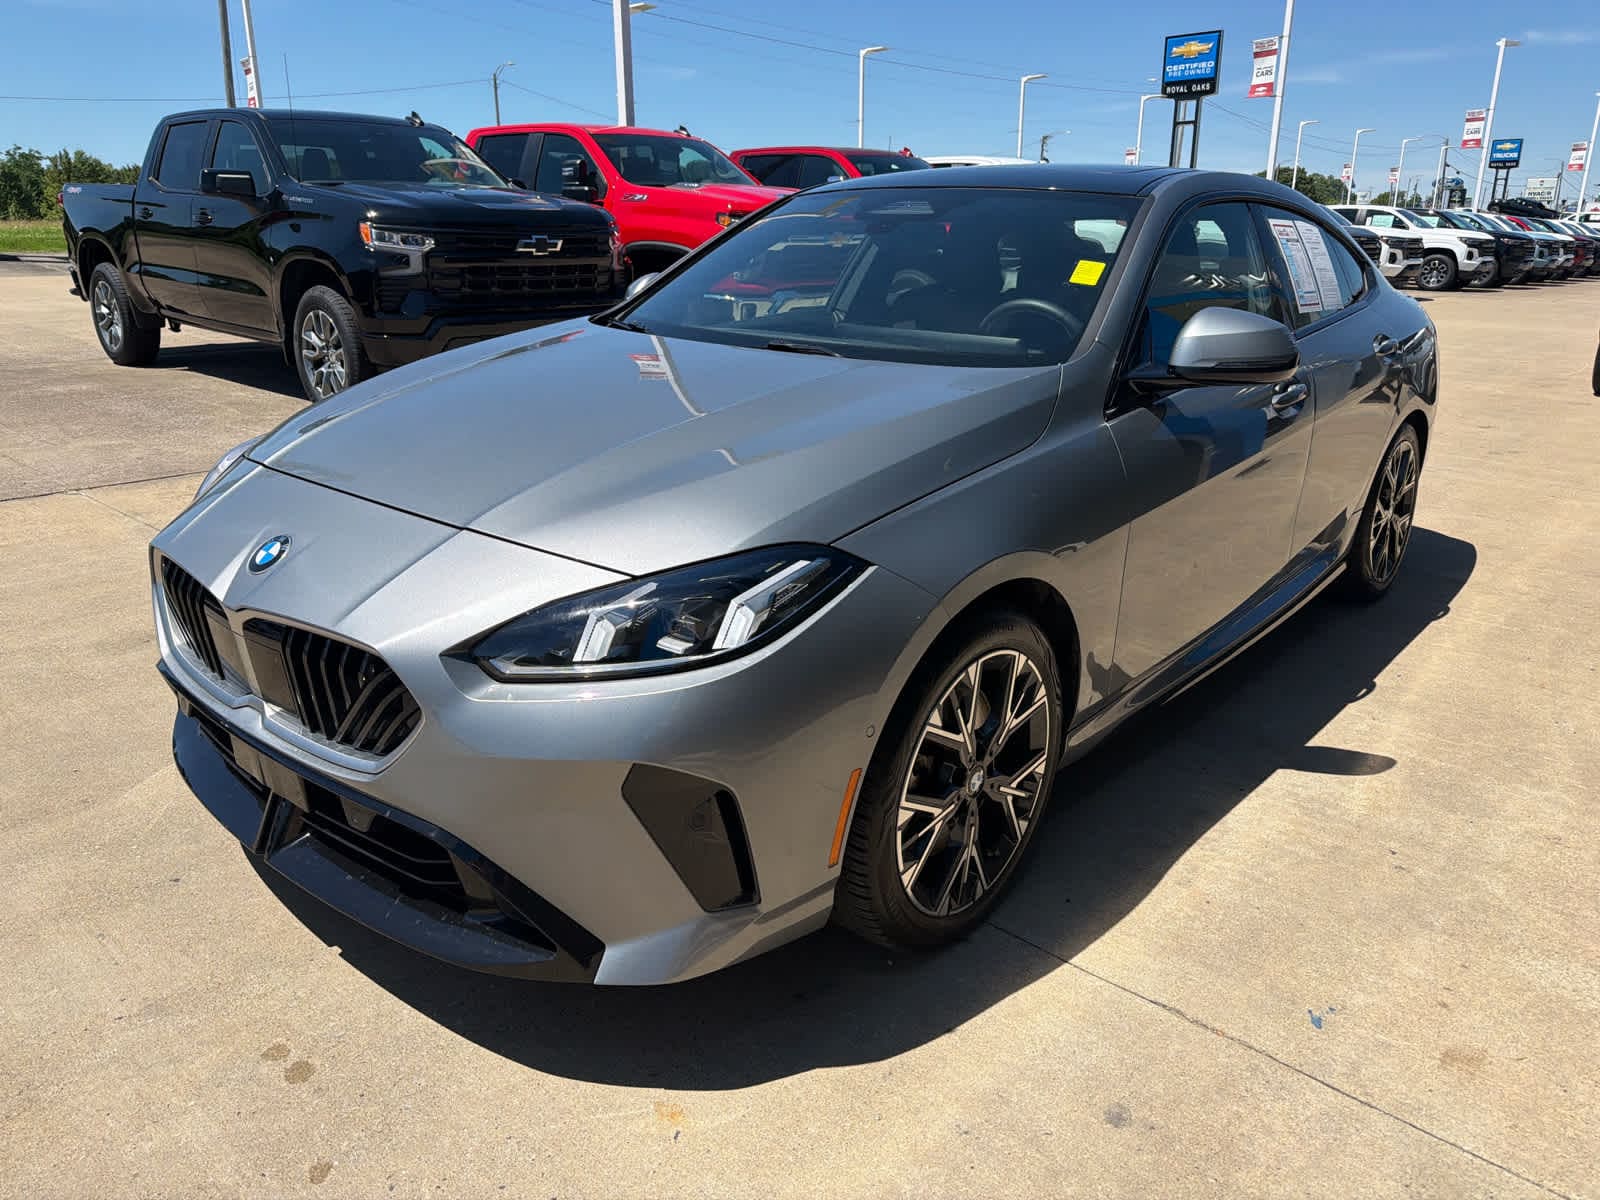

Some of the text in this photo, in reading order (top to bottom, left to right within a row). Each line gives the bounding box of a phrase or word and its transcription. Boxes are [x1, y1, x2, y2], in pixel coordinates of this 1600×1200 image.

[1166, 61, 1215, 72] CERTIFIED
[1255, 69, 1273, 77] CARS
[1166, 83, 1211, 94] ROYAL OAKS
